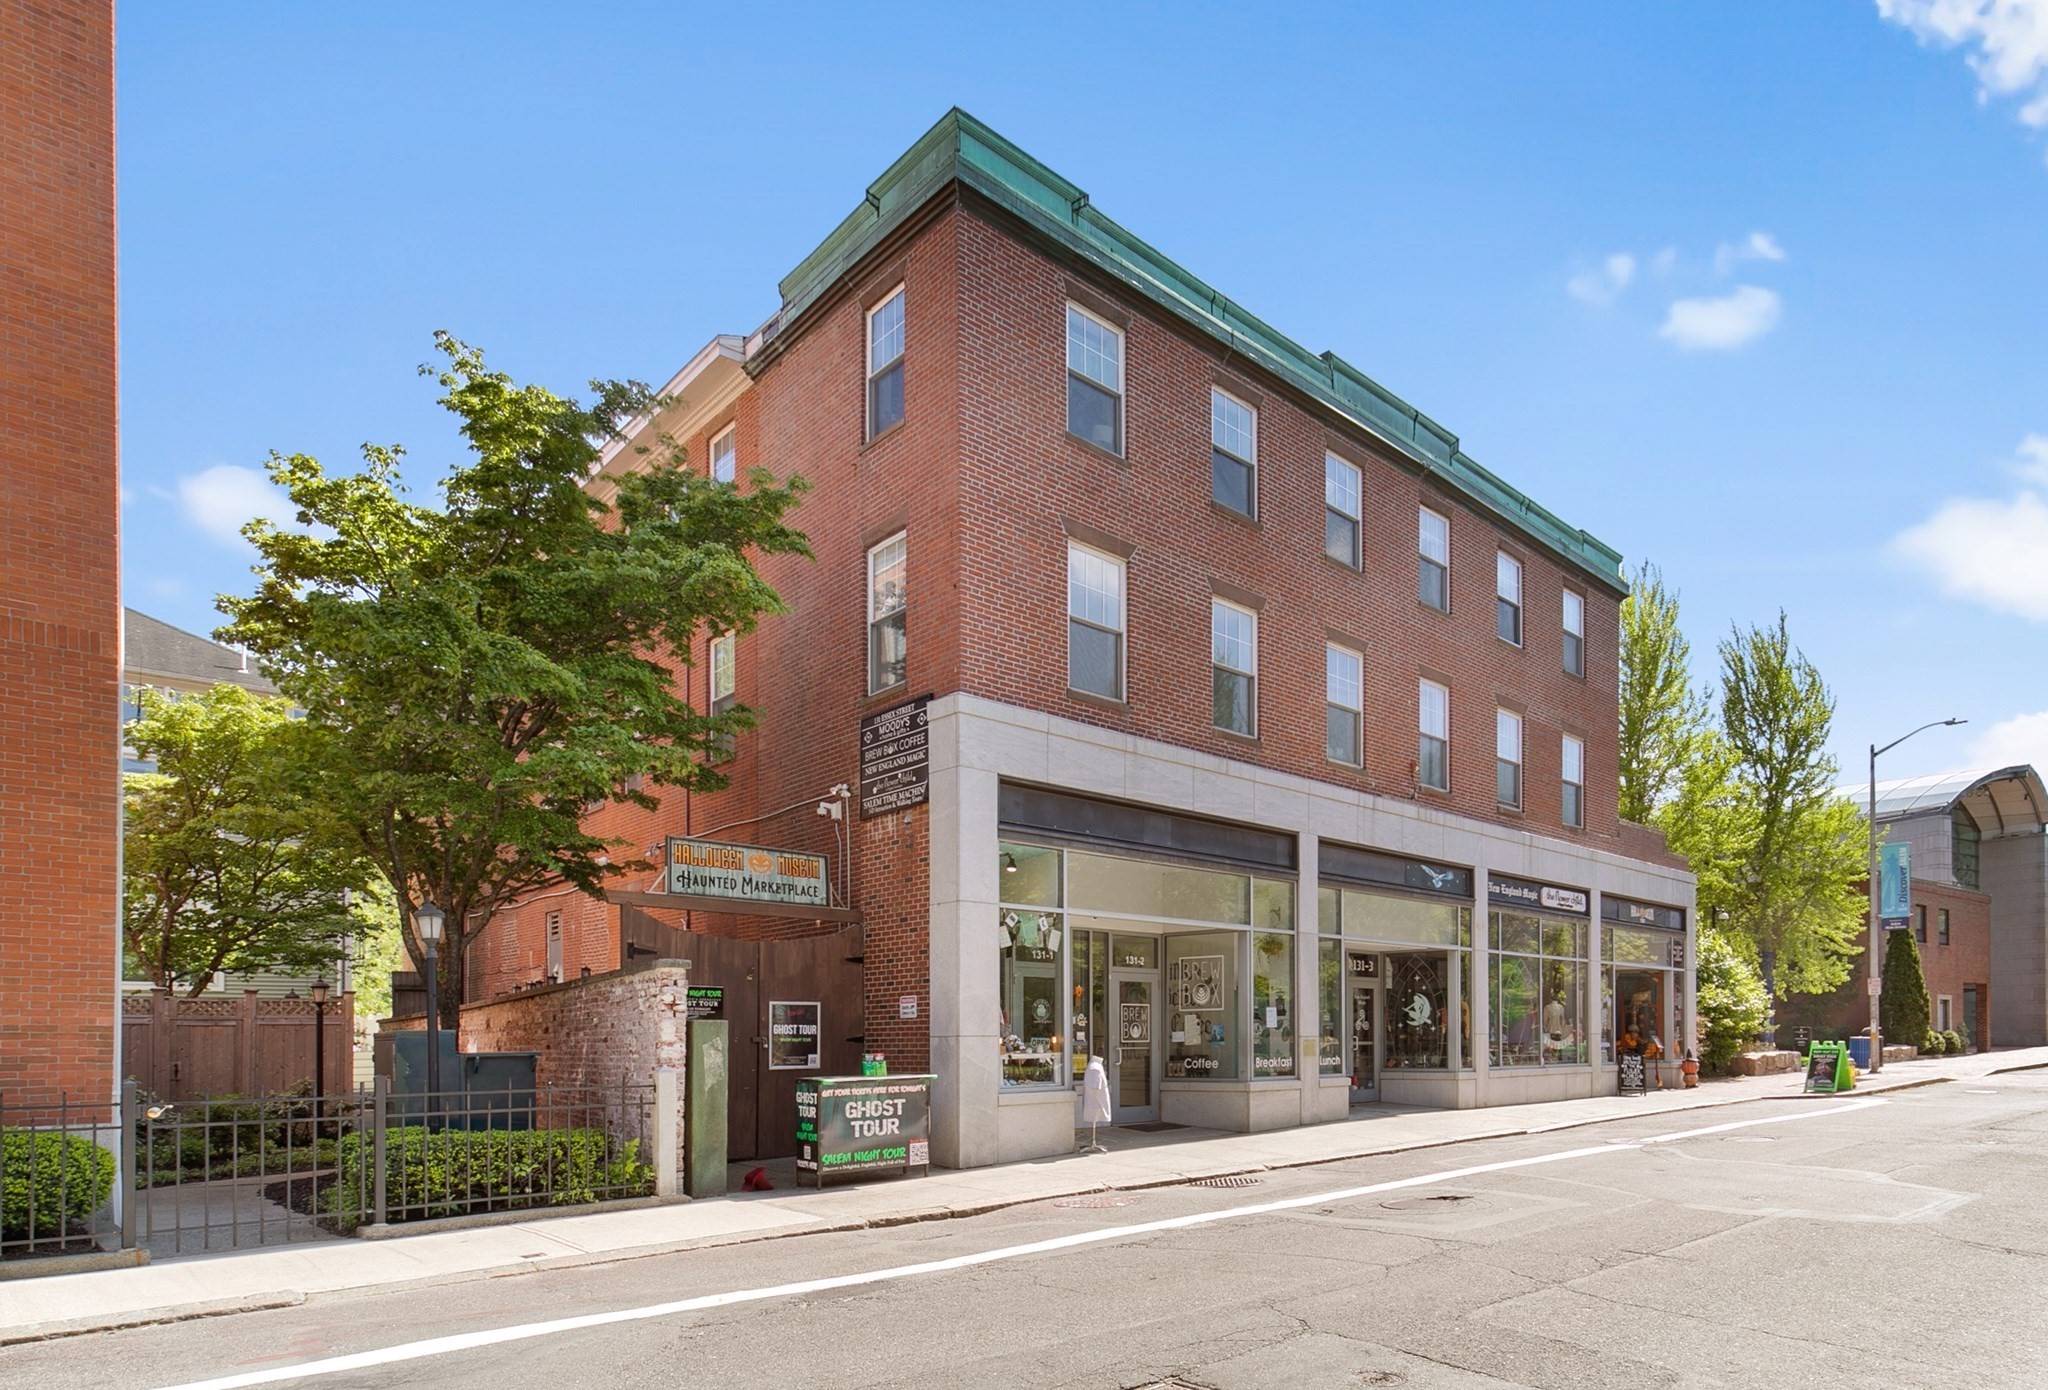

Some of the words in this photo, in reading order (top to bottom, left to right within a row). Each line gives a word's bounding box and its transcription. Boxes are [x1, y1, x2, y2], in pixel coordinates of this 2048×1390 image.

[896, 703, 915, 716] STREET
[865, 748, 882, 761] BREW
[884, 741, 898, 756] BOX
[899, 733, 925, 750] COFFEE
[865, 765, 878, 776] NEW
[879, 757, 906, 771] ENGLAND
[907, 750, 926, 763] MAGIC
[864, 798, 882, 809] SALEM
[883, 793, 898, 804] TIME
[673, 843, 744, 871] HALLOWEEN
[777, 855, 821, 879] MUSEUM
[677, 870, 737, 890] HAUNTED
[742, 877, 818, 898] MARKETPLACE
[1488, 882, 1500, 894] New
[1501, 884, 1522, 898] England
[1523, 889, 1538, 900] Magic
[1898, 866, 1908, 903] Discover
[1032, 950, 1054, 960] 131-1
[1125, 956, 1145, 965] 131-2
[1183, 961, 1221, 981] BREW
[1353, 959, 1374, 972] 131-3
[1183, 983, 1221, 1006] BOX
[1123, 1007, 1148, 1021] BREW
[773, 1024, 798, 1035] GHOST
[799, 1024, 817, 1035] TOUR
[1123, 1022, 1148, 1039] BOX
[1032, 1039, 1050, 1048] OPEN
[1184, 1058, 1219, 1069] Coffee
[1255, 1056, 1293, 1068] Breakfast
[1320, 1055, 1341, 1066] Lunch
[796, 1091, 818, 1105] GHOST
[798, 1105, 816, 1118] TOUR
[845, 1099, 906, 1119] GHOST
[851, 1118, 900, 1138] TOUR
[822, 1152, 851, 1166] SALEM
[854, 1149, 880, 1162] NIGHT
[882, 1147, 906, 1159] TOUR
